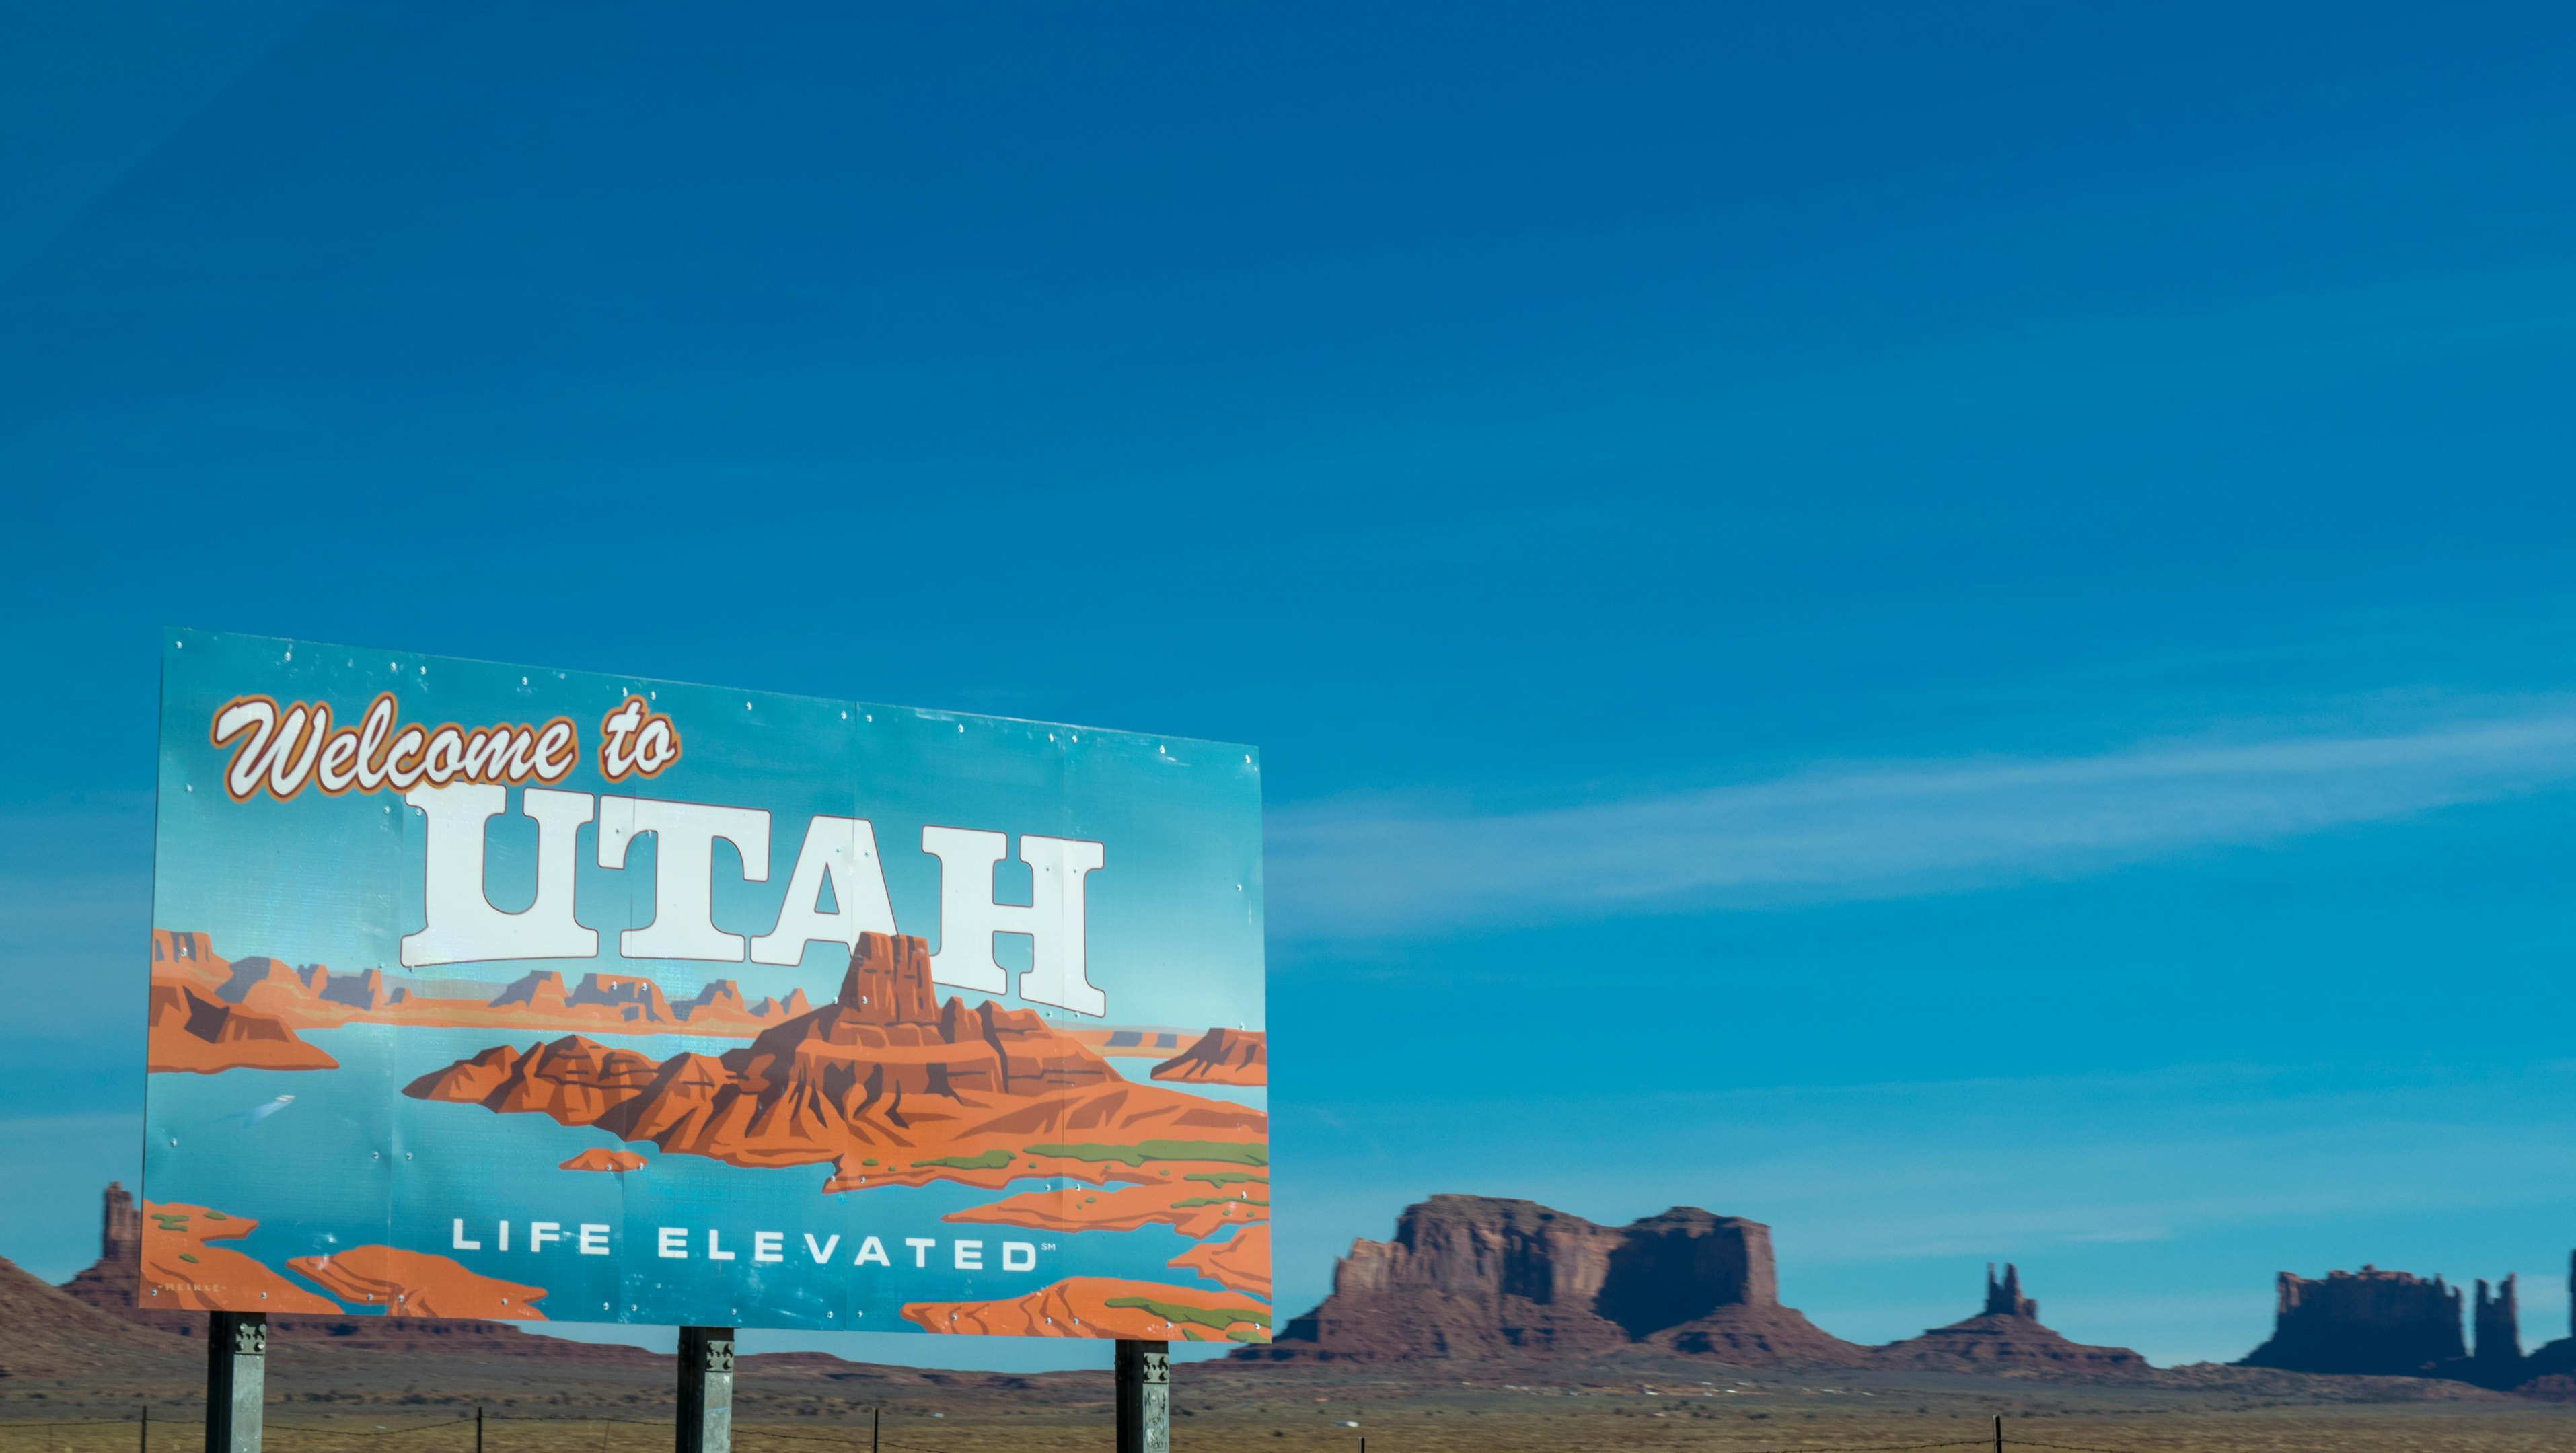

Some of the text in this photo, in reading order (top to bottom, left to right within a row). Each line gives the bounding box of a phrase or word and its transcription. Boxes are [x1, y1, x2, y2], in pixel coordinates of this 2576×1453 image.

[212, 692, 681, 801] Welcome to
[400, 781, 1105, 1018] UTAH
[453, 1218, 610, 1255] LIFE
[658, 1227, 1036, 1271] ELEVATED
